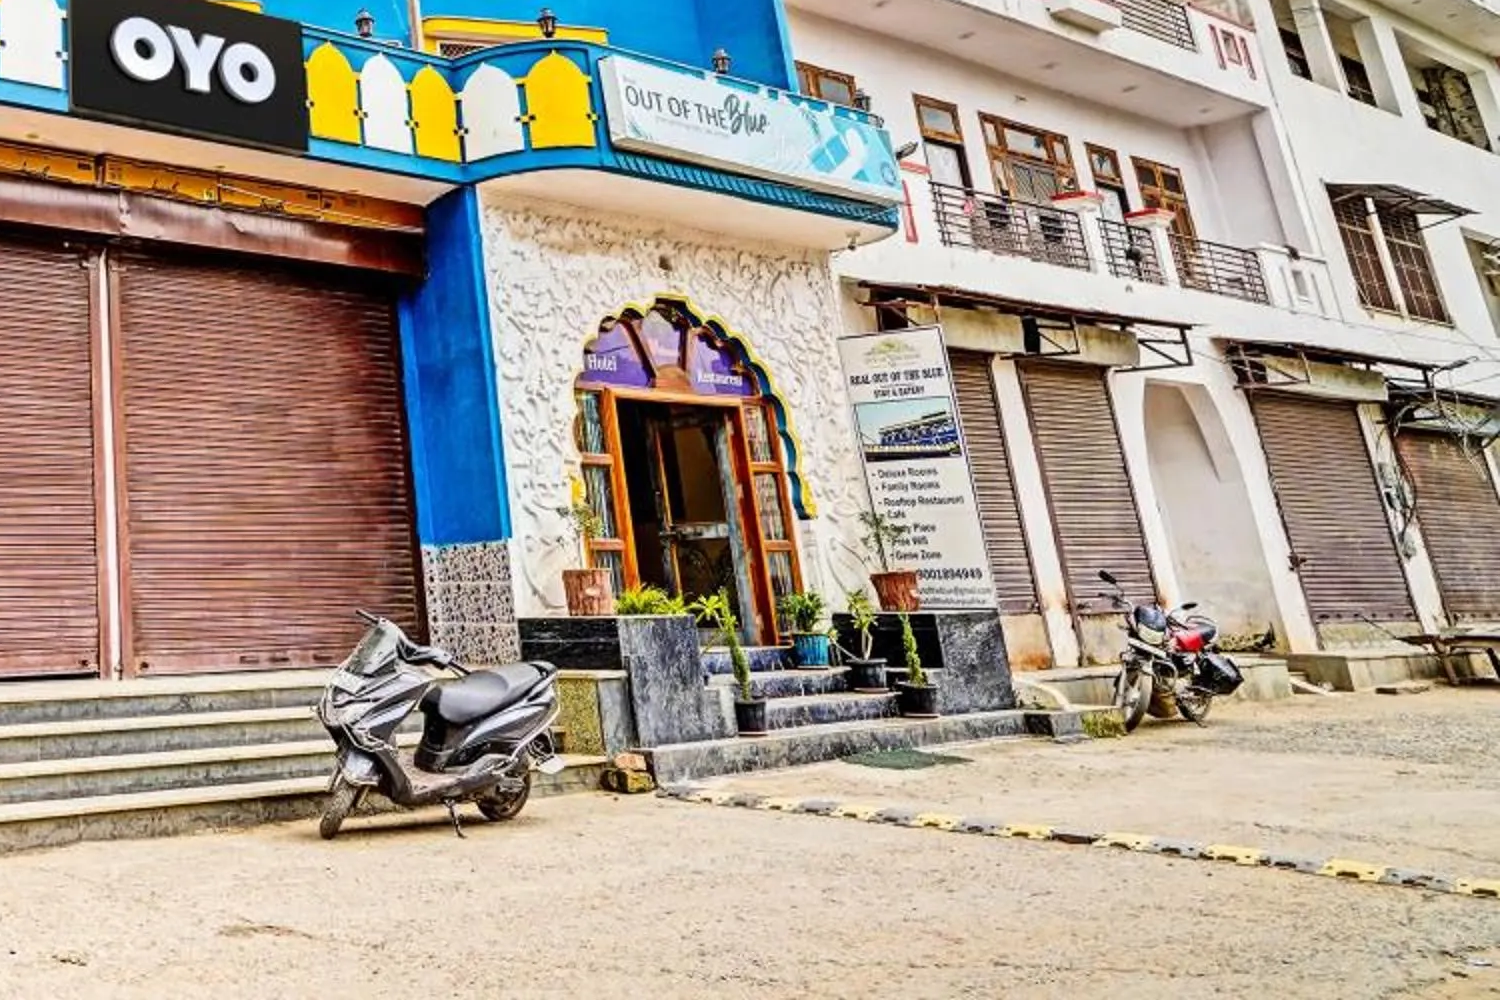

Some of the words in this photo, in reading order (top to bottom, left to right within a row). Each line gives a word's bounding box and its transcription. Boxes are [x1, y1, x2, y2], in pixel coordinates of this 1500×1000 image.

[110, 16, 277, 104] OYO
[625, 85, 663, 112] OUT
[668, 96, 692, 119] OF
[694, 103, 728, 130] THE
[723, 93, 768, 137] Blue
[850, 374, 871, 385] REAL
[872, 372, 889, 383] OUT
[890, 371, 901, 382] OF
[903, 369, 921, 381] THE
[922, 367, 945, 379] BLUE
[898, 386, 925, 397] EATERY
[907, 467, 939, 477] Rooms
[881, 482, 909, 492] Family
[909, 481, 941, 490] Rooms
[912, 523, 937, 533] Place
